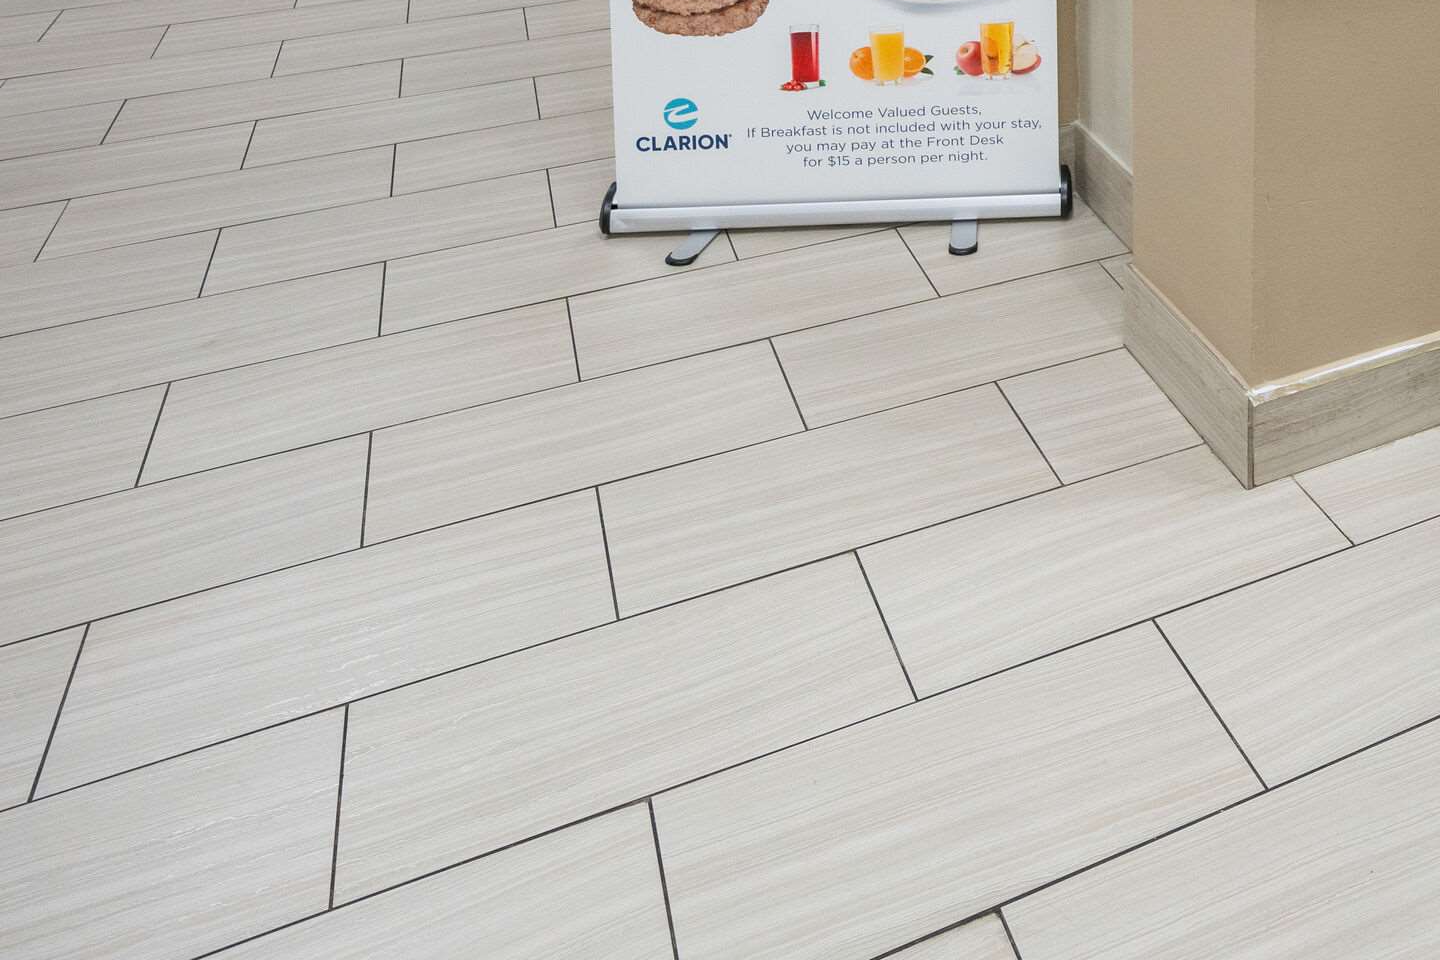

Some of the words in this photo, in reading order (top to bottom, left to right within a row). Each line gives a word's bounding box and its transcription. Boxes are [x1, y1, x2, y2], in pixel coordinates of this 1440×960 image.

[806, 108, 873, 121] Welcome
[877, 105, 926, 119] Valued
[930, 104, 982, 117] Guests,
[747, 127, 757, 139] If
[760, 125, 828, 138] Breakfast
[830, 123, 844, 136] is
[847, 123, 871, 135] not
[875, 120, 936, 134] included
[940, 119, 971, 132] with
[975, 120, 1007, 133] your
[1010, 119, 1042, 130] stay,
[635, 133, 733, 153] CLARION
[786, 143, 812, 155] you
[816, 142, 847, 153] may
[850, 141, 877, 153] pay
[880, 138, 895, 150] at
[899, 137, 923, 149] the
[927, 135, 965, 148] Front
[969, 134, 1005, 146] Desk
[802, 156, 824, 168] for
[827, 155, 850, 168] $15
[867, 155, 916, 168] person
[920, 153, 945, 165] per
[948, 150, 988, 164] night.
